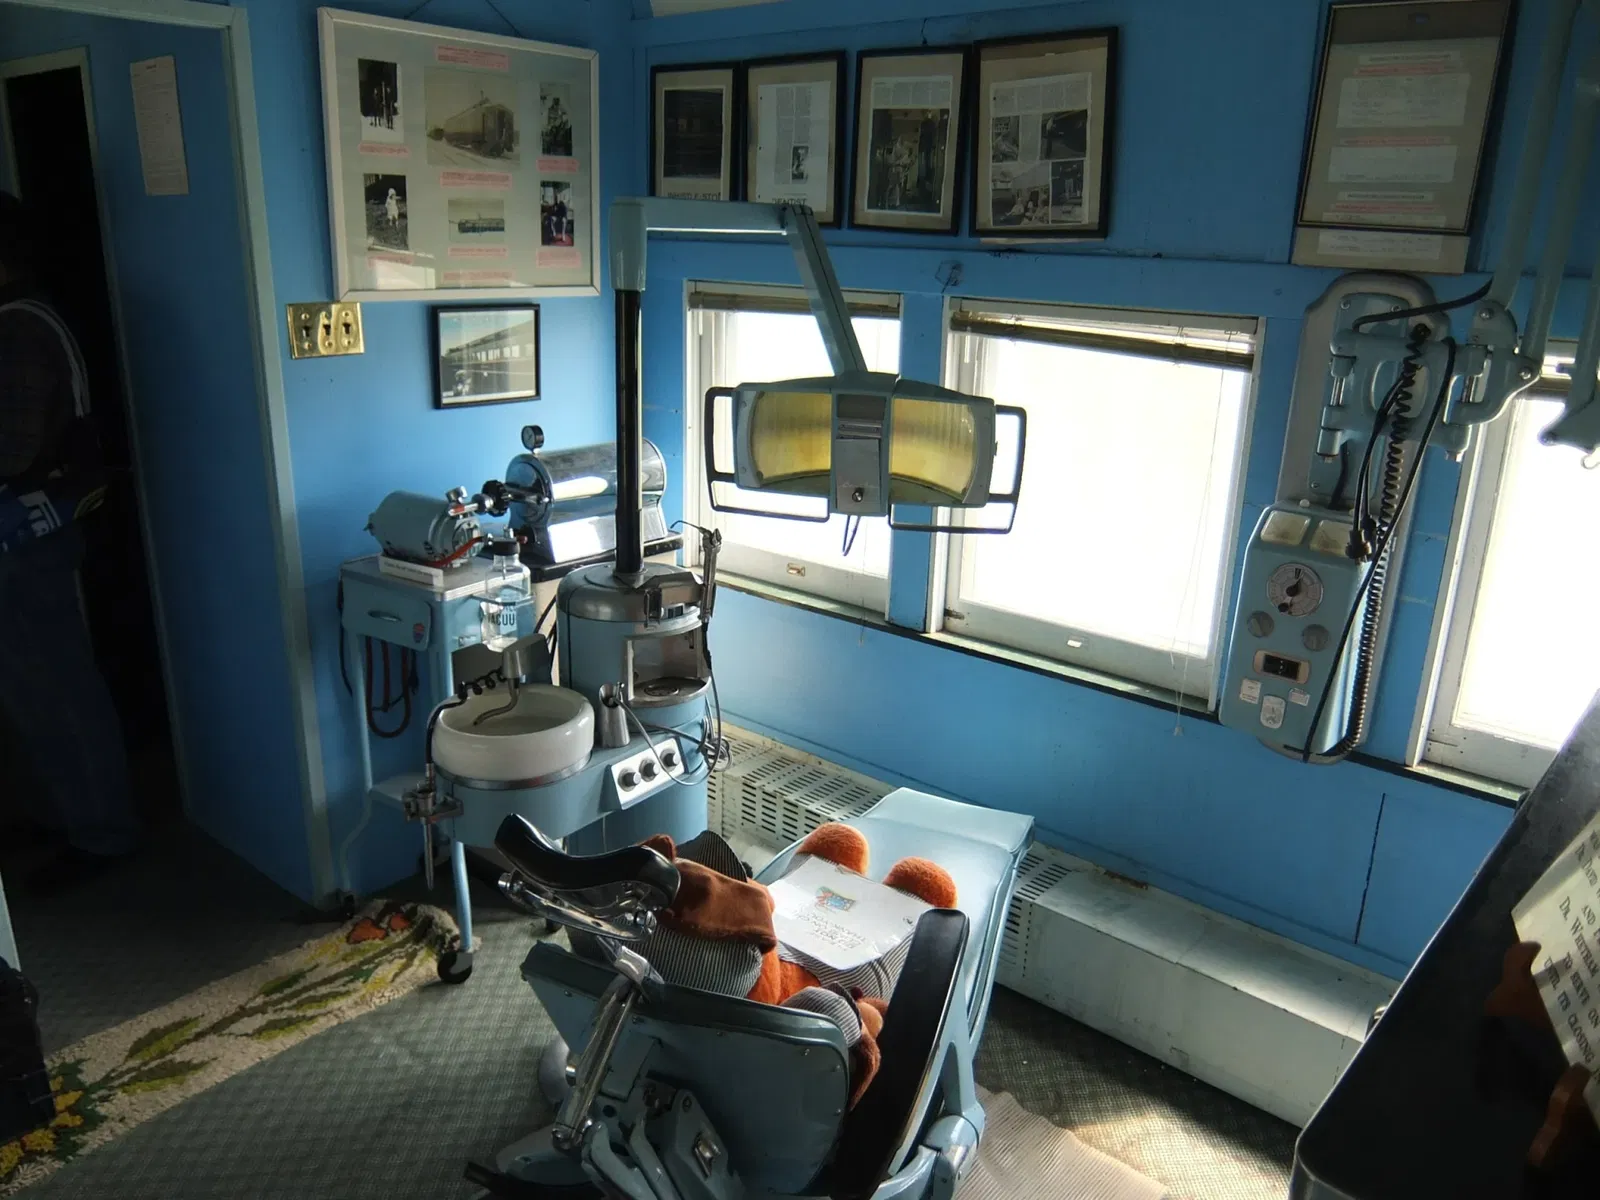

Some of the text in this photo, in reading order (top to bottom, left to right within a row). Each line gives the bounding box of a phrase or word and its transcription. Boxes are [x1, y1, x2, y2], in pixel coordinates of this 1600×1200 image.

[1581, 904, 1596, 925] AND
[1563, 951, 1573, 970] TO
[1570, 971, 1590, 1006] SERVE
[1558, 990, 1571, 1012] ITS
[1568, 1013, 1595, 1064] CLOSING
